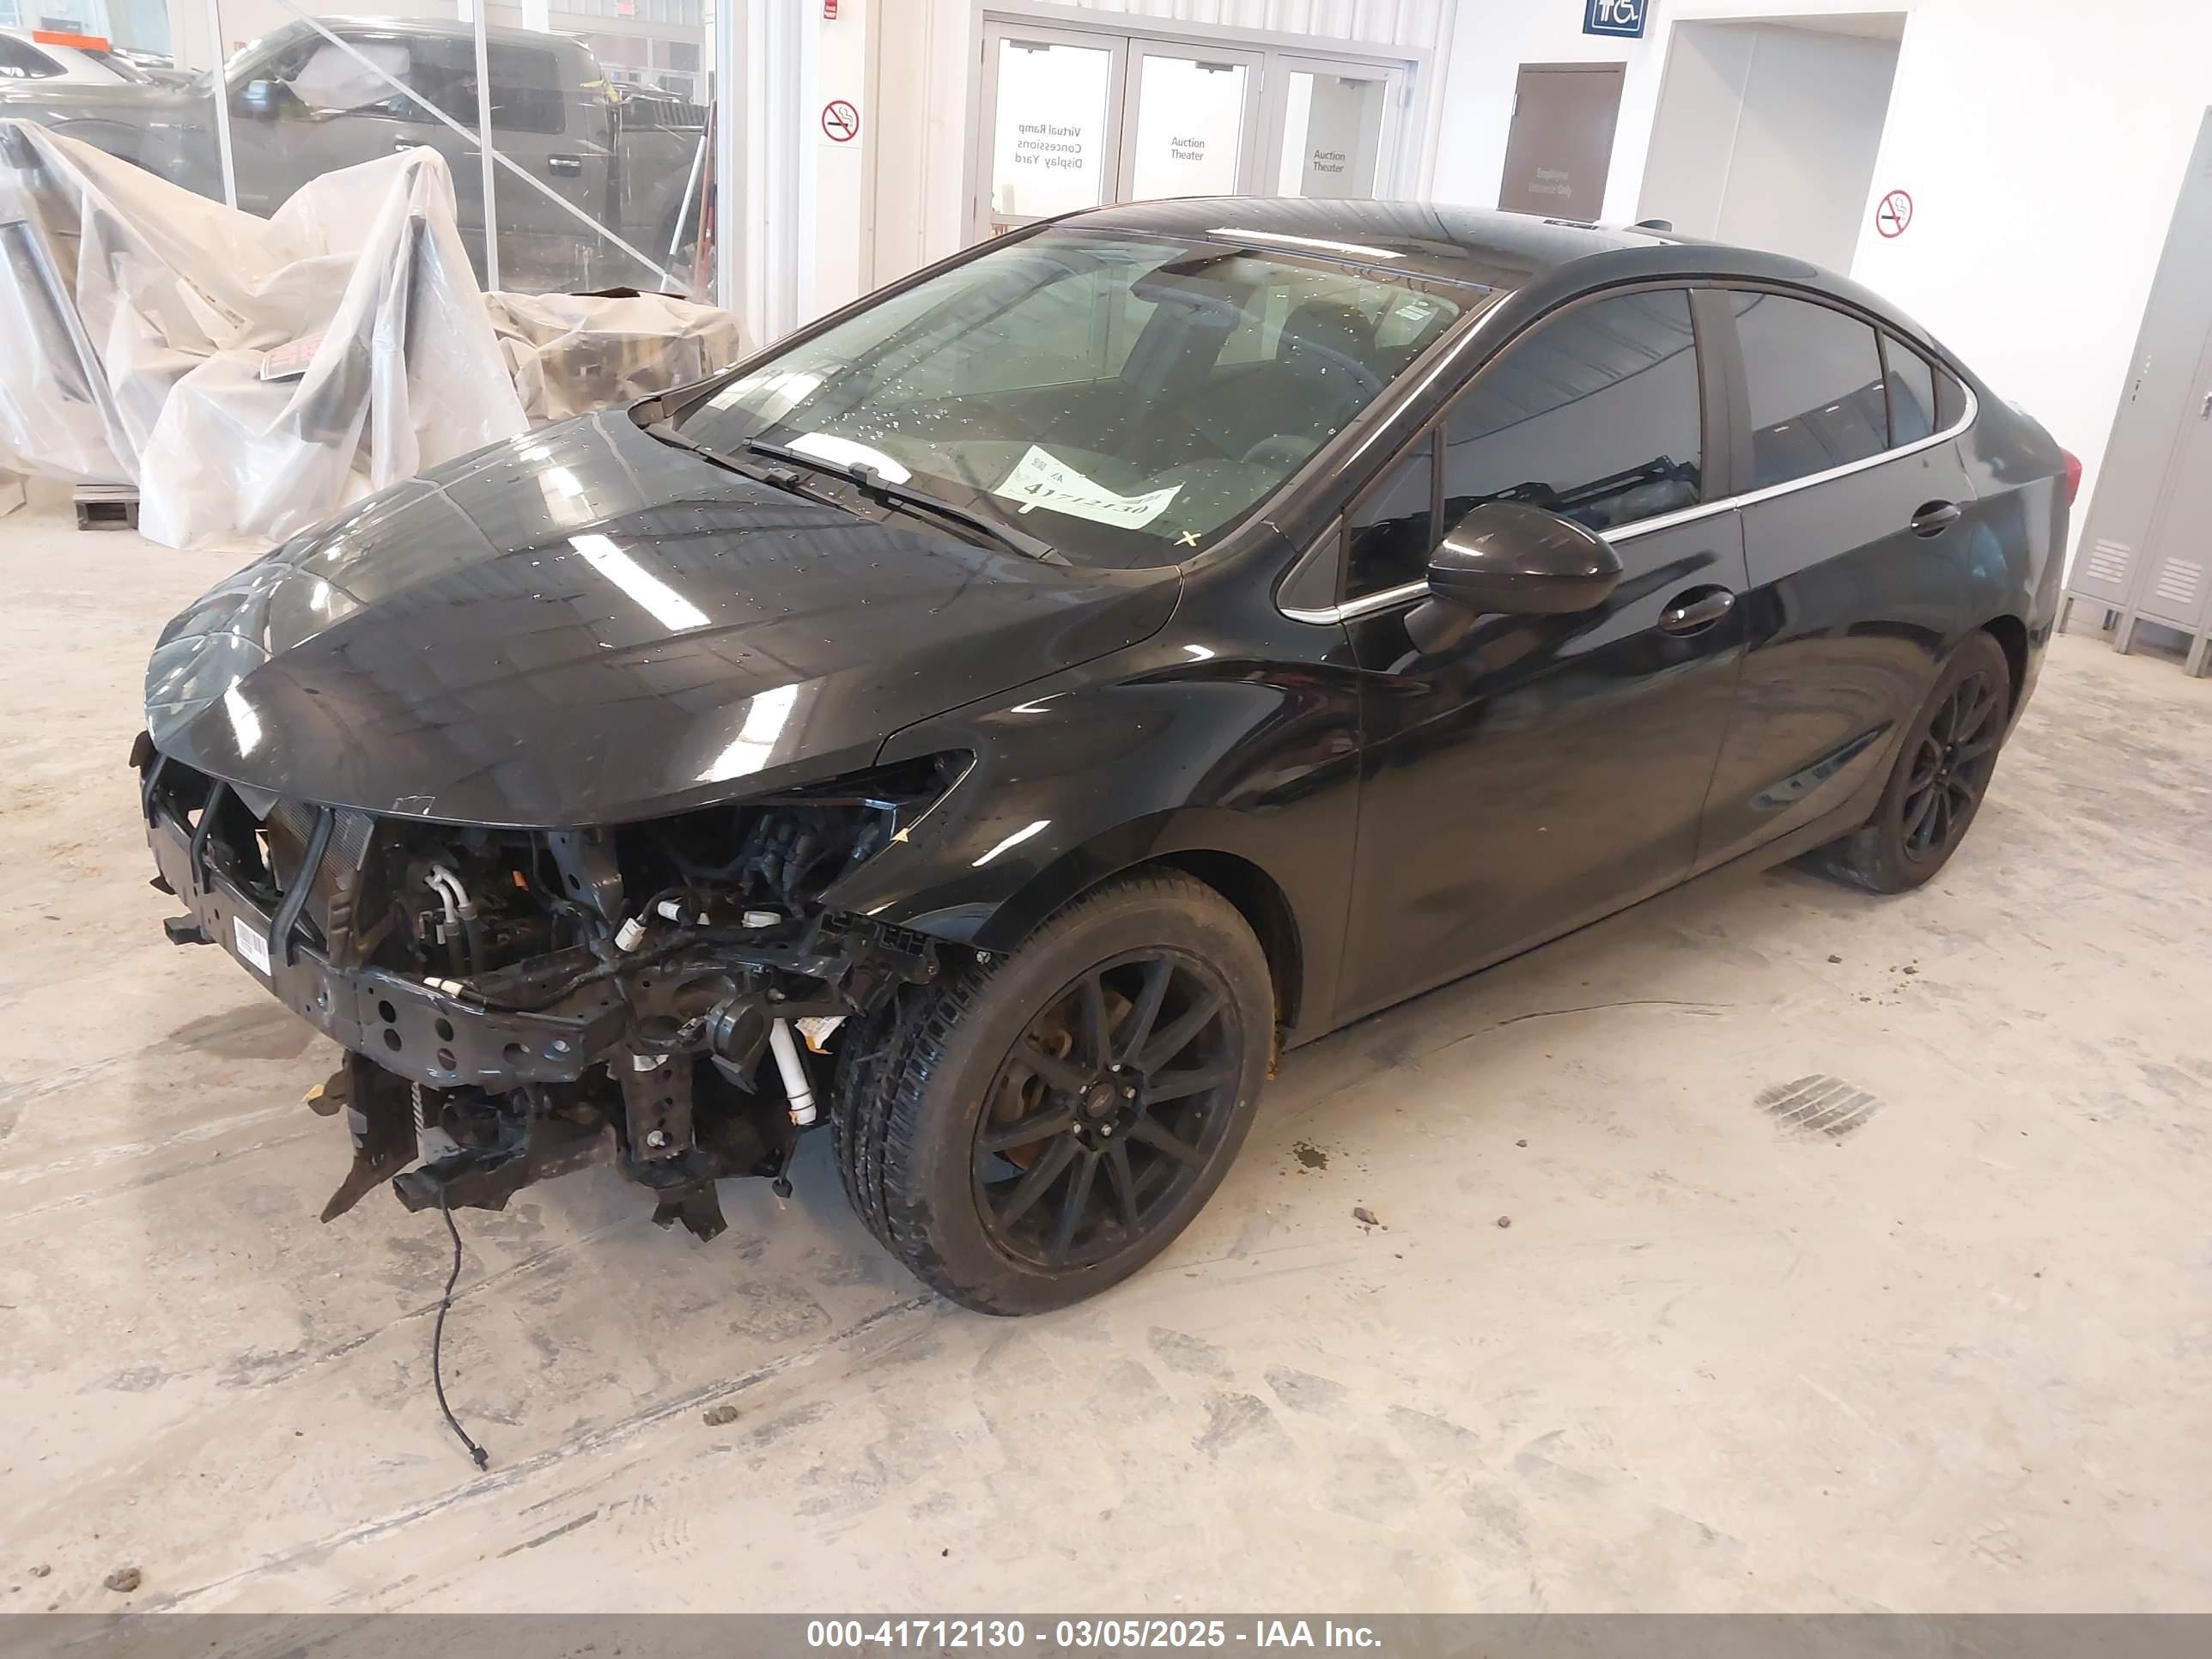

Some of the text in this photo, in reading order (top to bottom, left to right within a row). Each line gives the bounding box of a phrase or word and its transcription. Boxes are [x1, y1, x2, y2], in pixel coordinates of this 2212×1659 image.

[1170, 137, 1205, 149] Auction
[1171, 149, 1204, 161] Theater
[1313, 149, 1346, 161] Auction
[1313, 161, 1345, 173] Theater
[1024, 483, 1149, 514] 41712130
